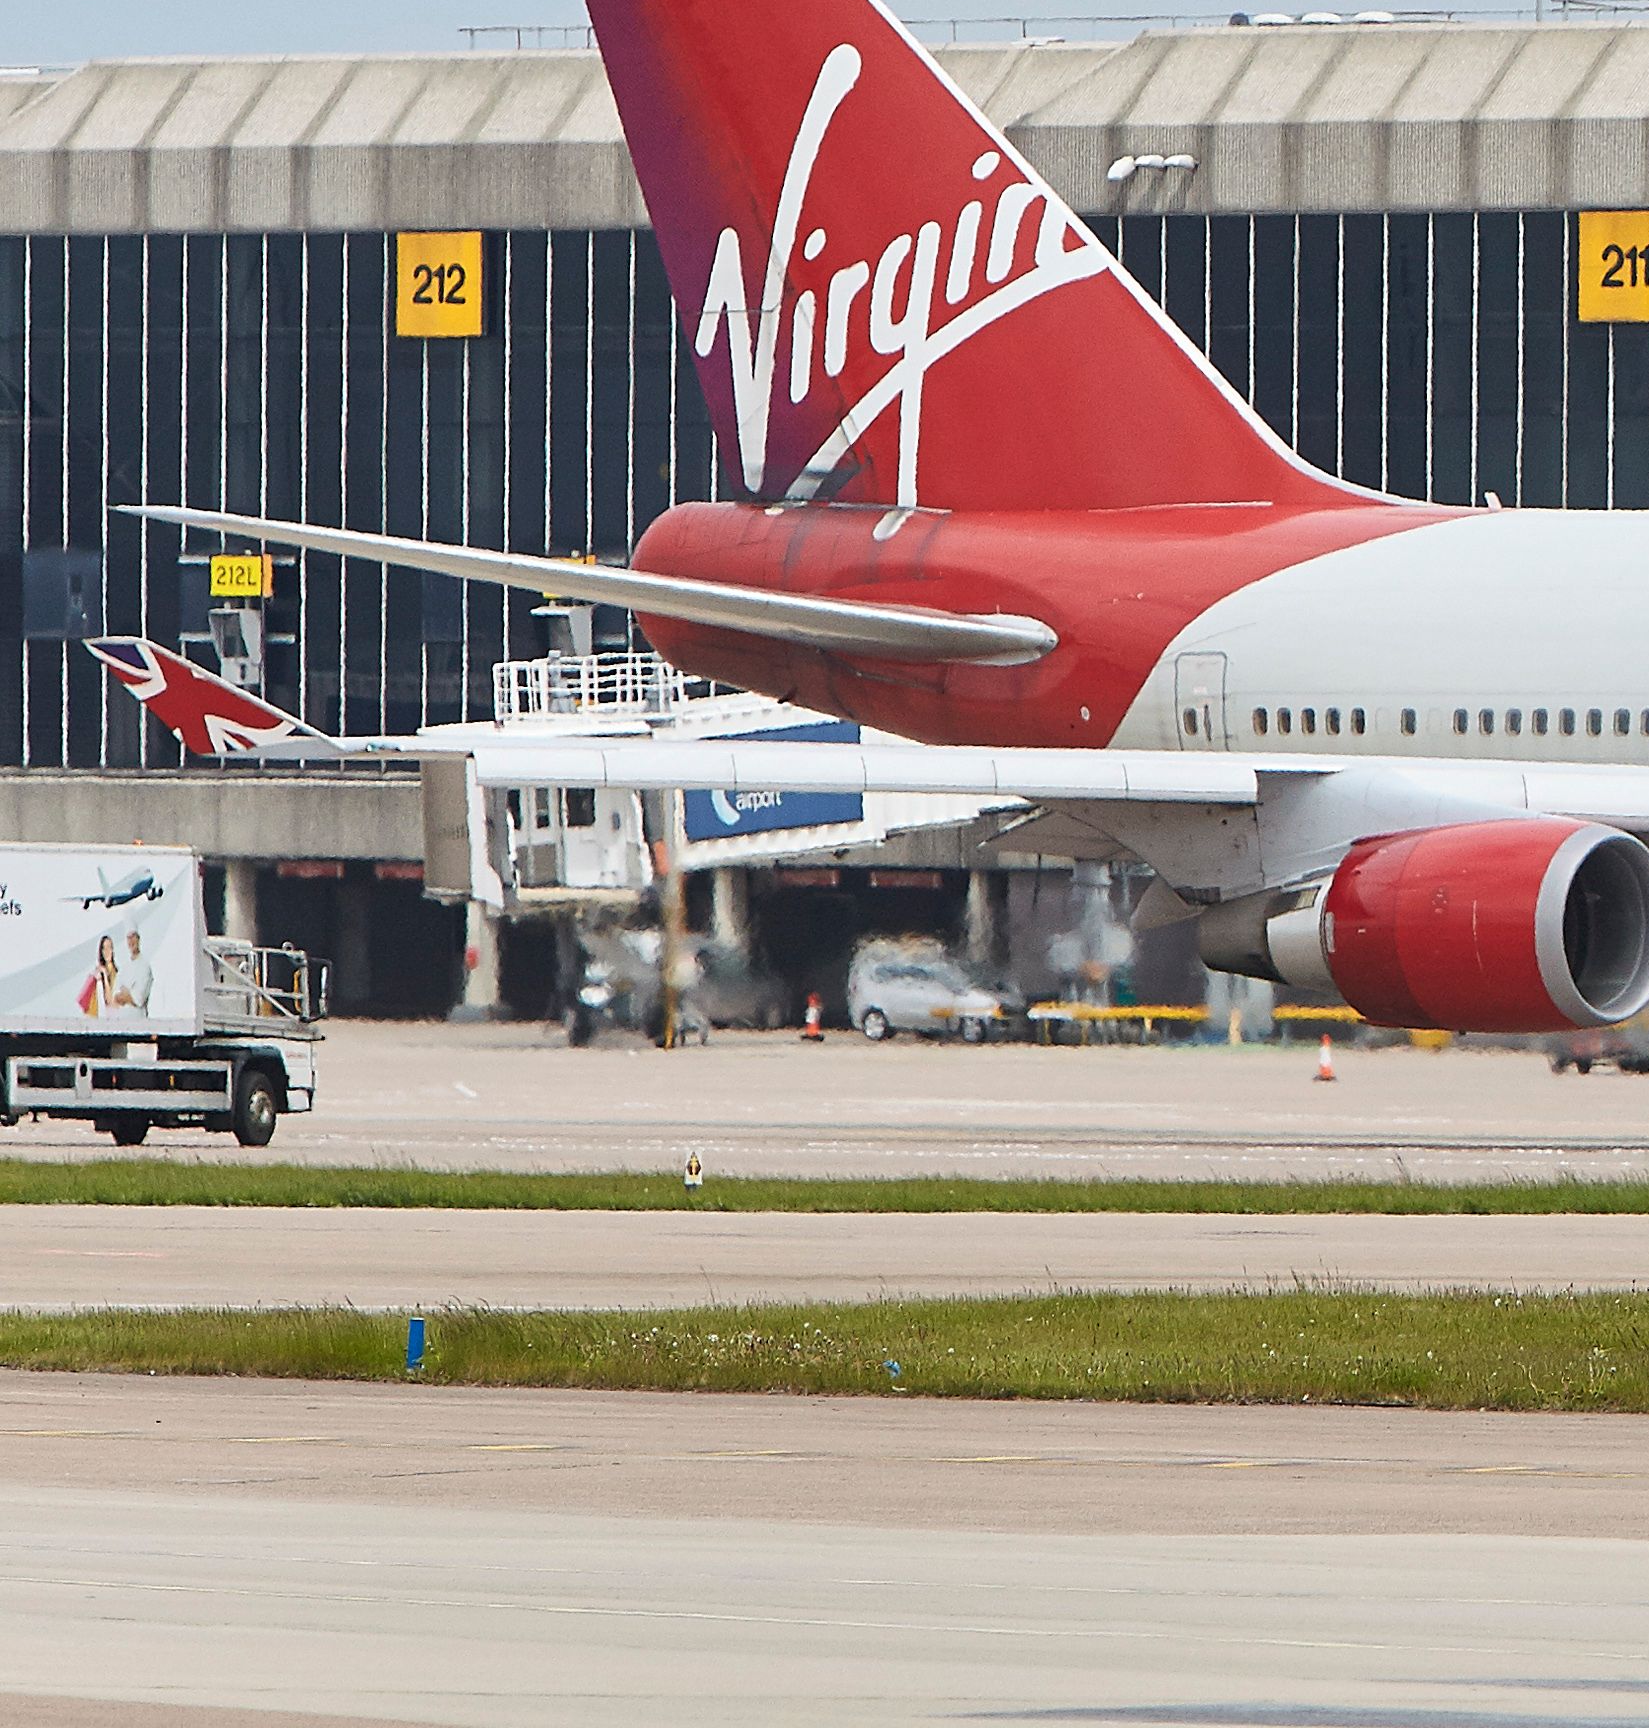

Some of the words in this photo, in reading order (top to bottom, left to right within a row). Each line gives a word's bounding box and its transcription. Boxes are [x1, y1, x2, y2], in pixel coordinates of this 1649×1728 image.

[413, 263, 467, 304] 212
[696, 43, 1111, 541] Virgin
[215, 564, 257, 587] 212L
